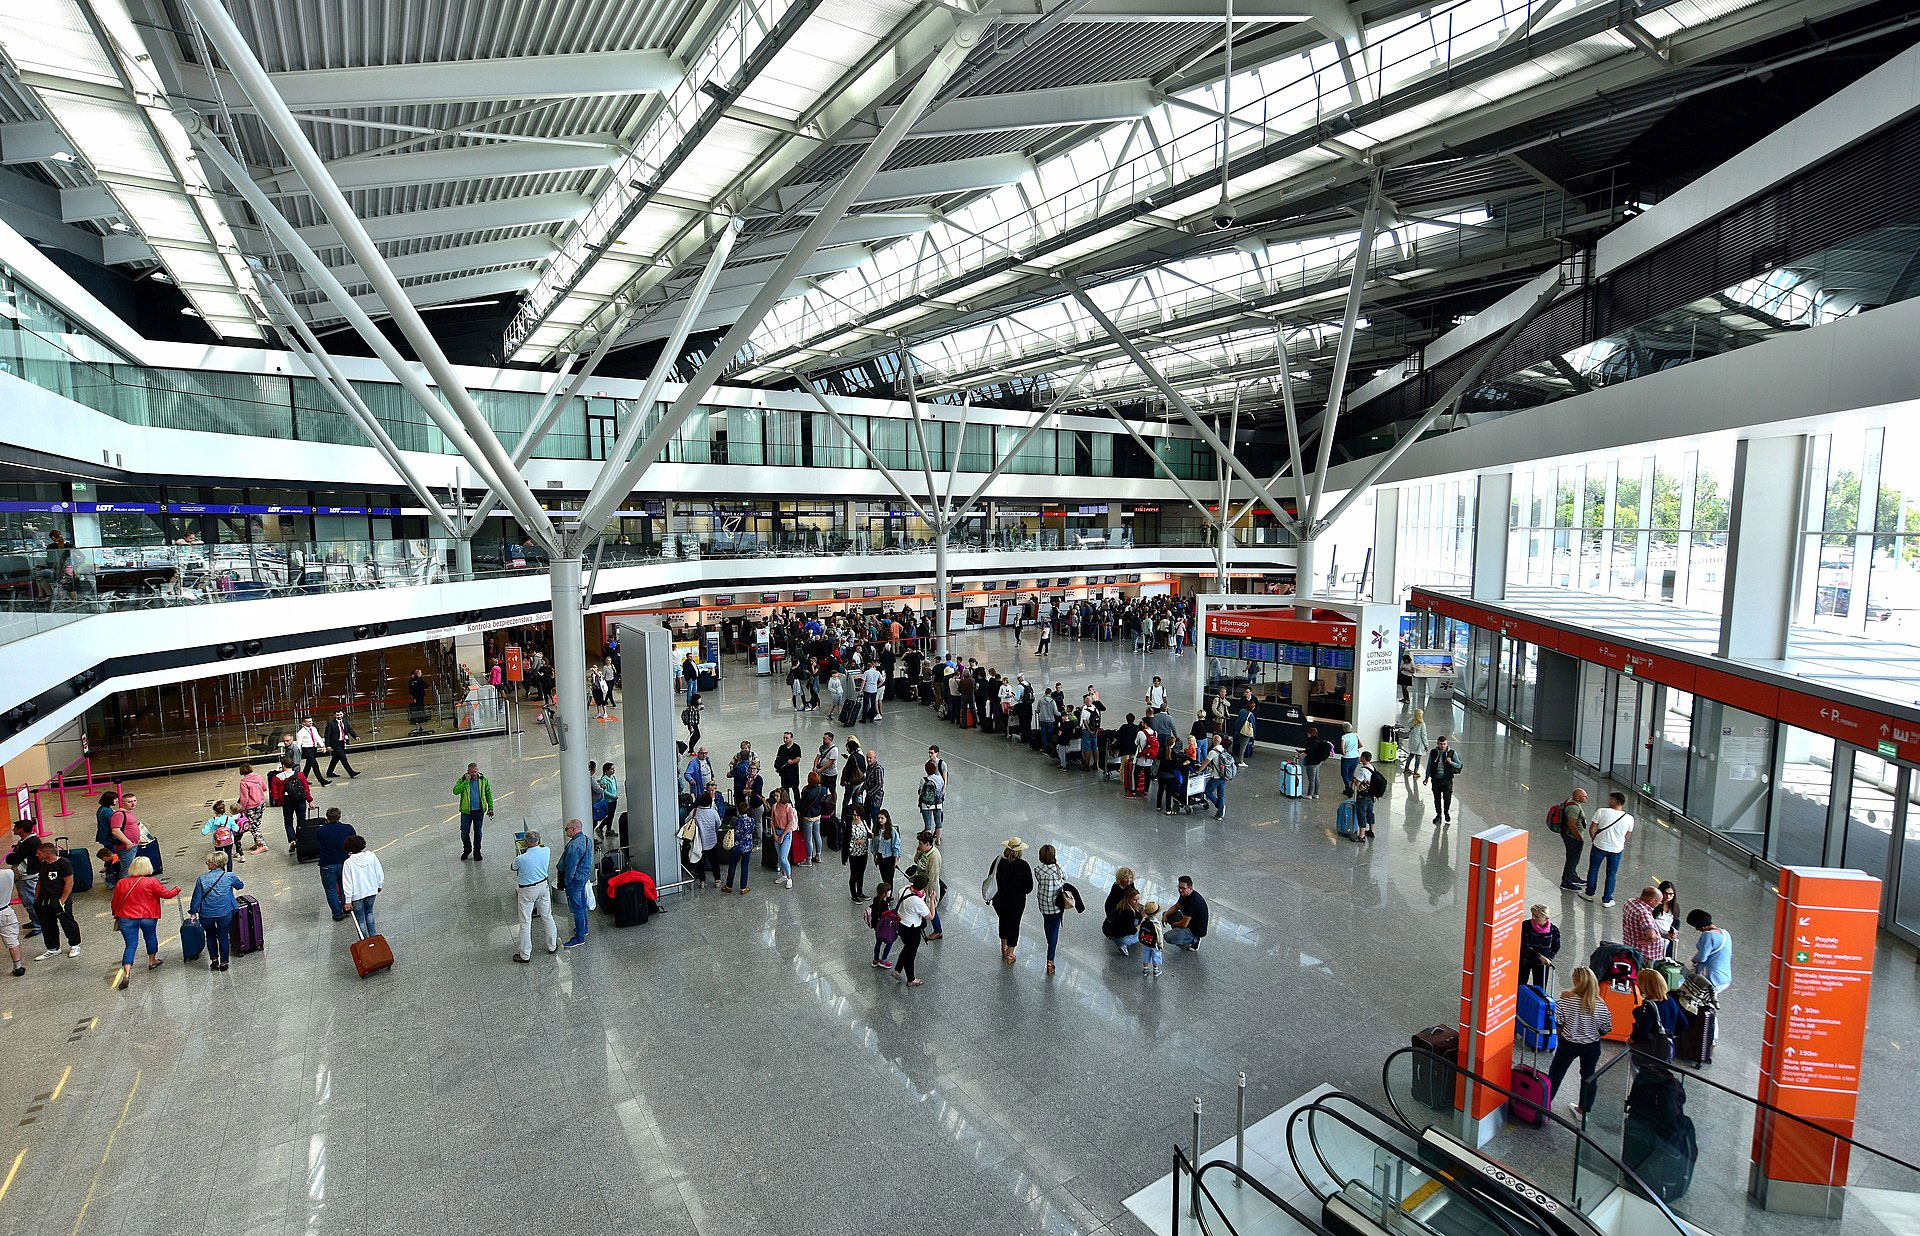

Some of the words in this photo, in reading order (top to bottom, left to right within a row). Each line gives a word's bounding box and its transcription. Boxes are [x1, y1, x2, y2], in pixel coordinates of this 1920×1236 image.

[95, 504, 114, 512] LOT
[466, 622, 492, 632] Kontrola
[492, 616, 533, 629] bezpieczeństwa
[1220, 619, 1250, 628] Informacja
[1220, 626, 1247, 634] Information
[1366, 650, 1393, 659] LOTNISKO
[1366, 658, 1393, 666] CHOPINA
[1814, 936, 1839, 944] Przyloty
[1818, 974, 1862, 982] bezpieczeństwa
[1806, 1017, 1841, 1025] ekonomiczna
[1788, 1027, 1813, 1035] Economy
[1799, 1060, 1835, 1068] ekonomiczna
[1782, 1070, 1806, 1078] Economy
